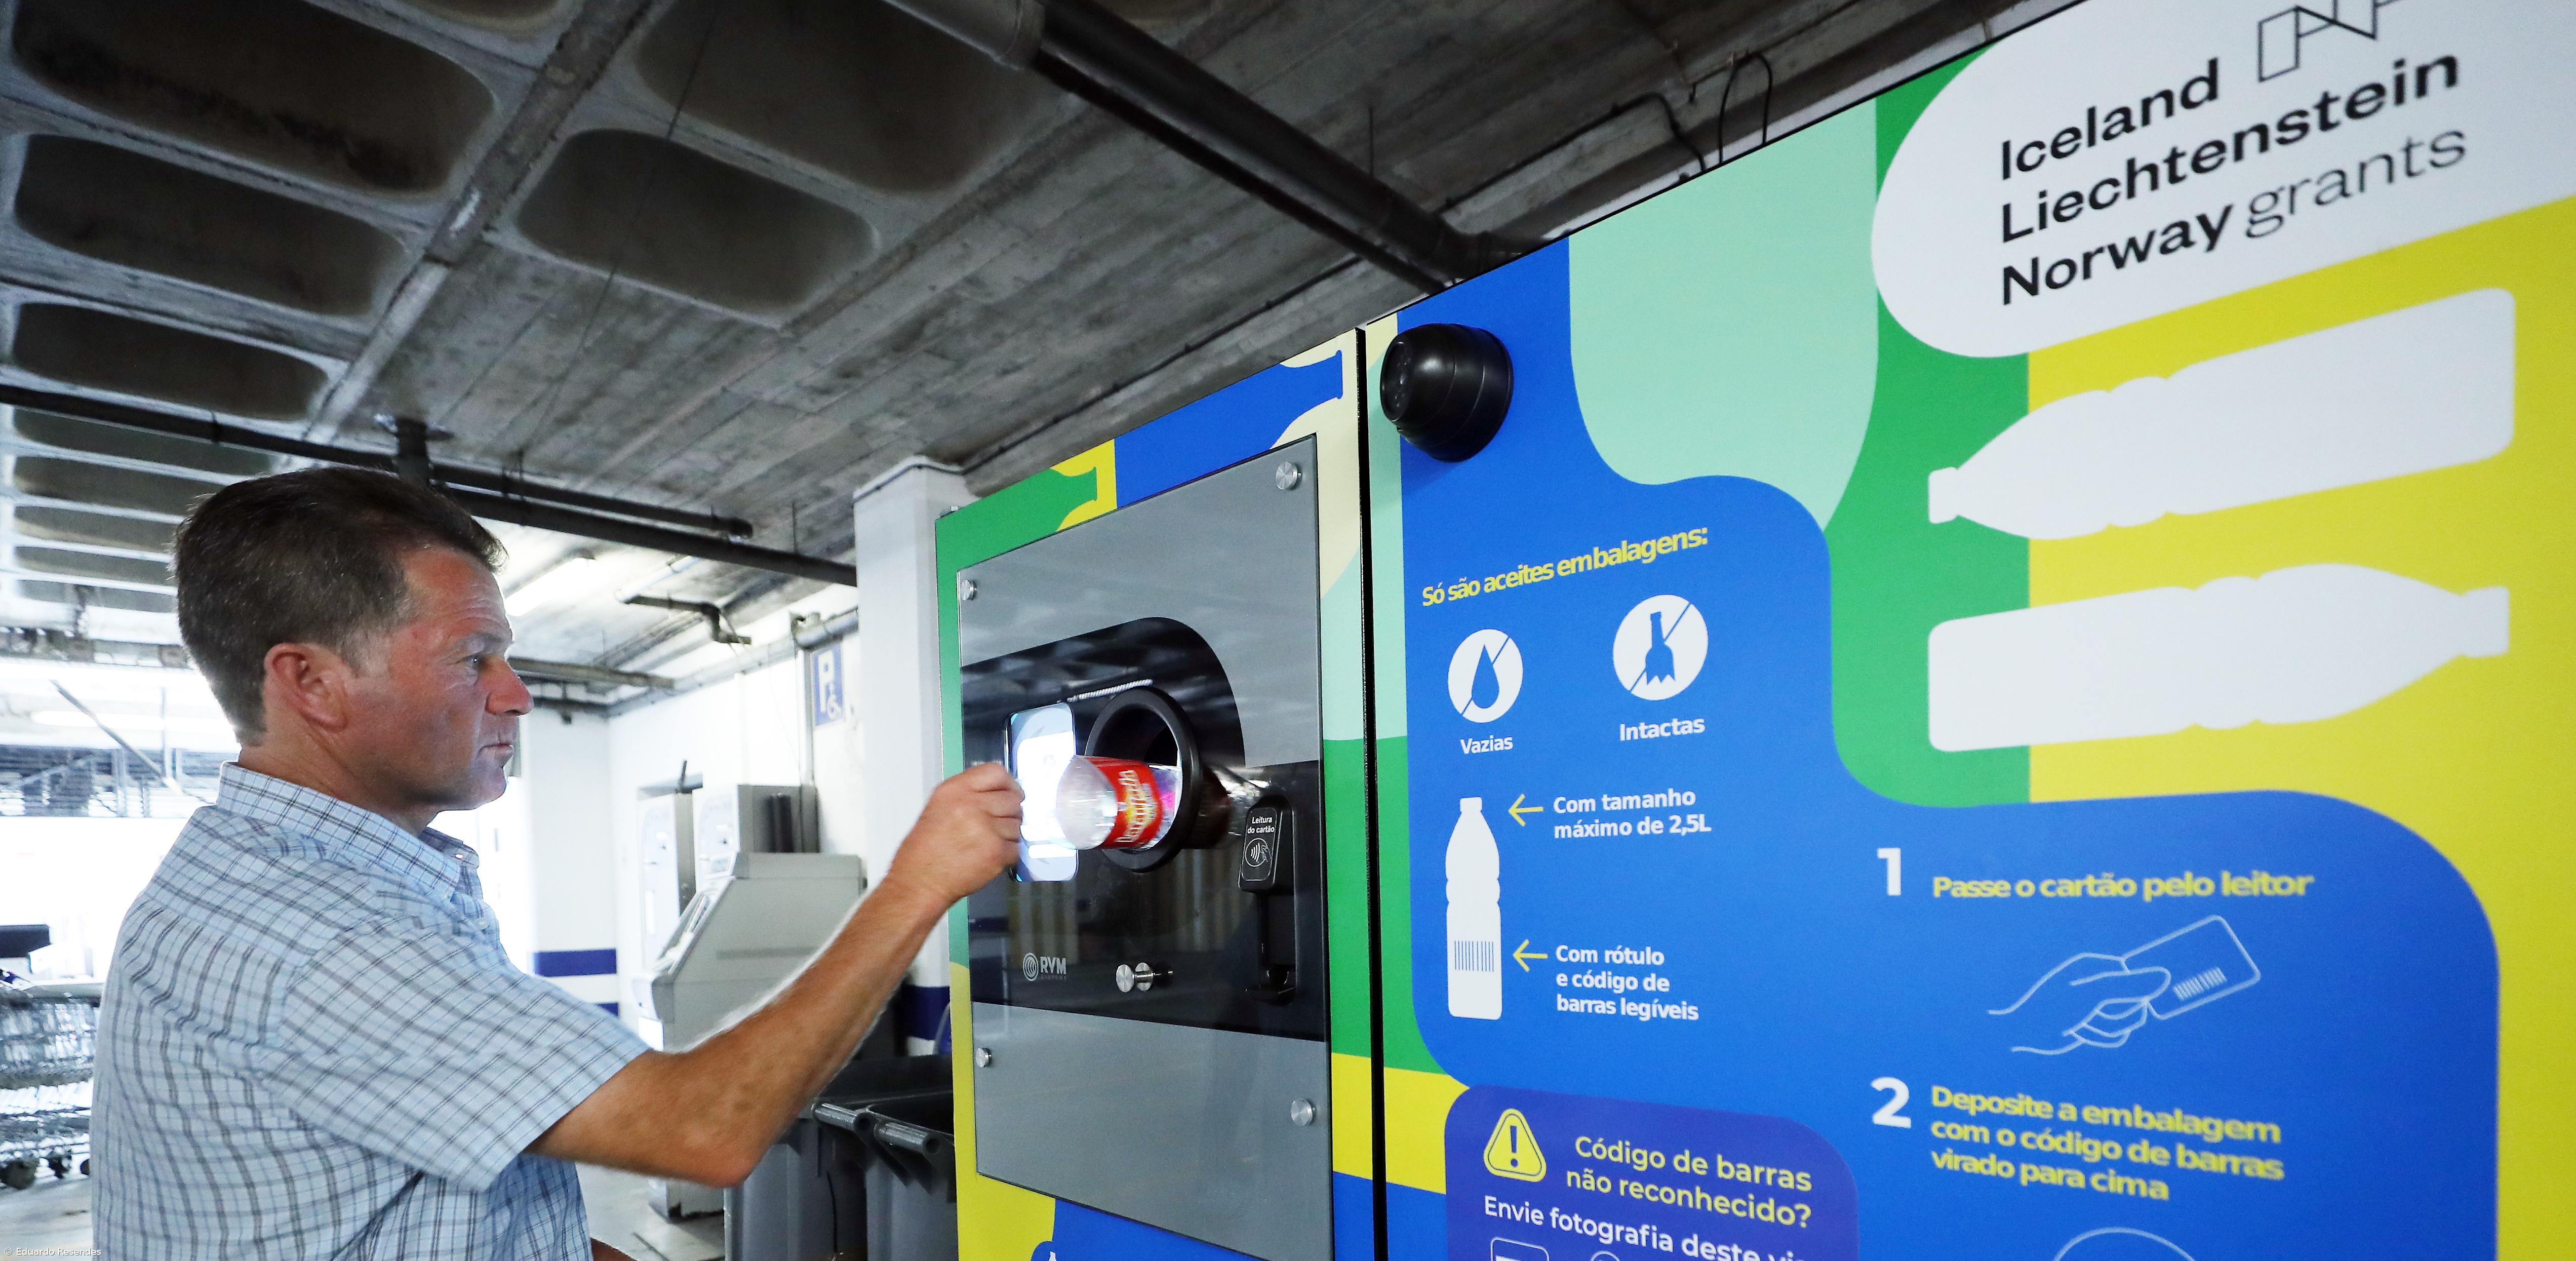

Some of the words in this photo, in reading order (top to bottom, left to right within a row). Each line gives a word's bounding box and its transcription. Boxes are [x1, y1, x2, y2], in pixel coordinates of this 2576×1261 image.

[2001, 57, 2220, 181] Iceland
[2001, 55, 2460, 243] Liechtenstein
[2003, 202, 2233, 305] Norway
[2246, 131, 2465, 238] grants
[1423, 582, 1445, 606] Só
[1448, 577, 1480, 600] são
[1484, 563, 1554, 593] aceites
[1557, 528, 1708, 576] embalagens:
[818, 649, 835, 713] P
[1460, 735, 1513, 754] Vazias
[1620, 719, 1705, 740] Intactas
[1554, 797, 1596, 813] Com
[1602, 789, 1696, 810] tamanho
[1555, 819, 1632, 838] máximo
[1637, 816, 1663, 835] de
[1669, 814, 1712, 835] 2,5L
[1878, 848, 1901, 895] 1
[1933, 877, 2011, 897] Passe
[2015, 880, 2035, 897] o
[2040, 873, 2137, 897] cartão
[2144, 872, 2215, 901] pelo
[2222, 871, 2313, 895] leitor
[1040, 956, 1066, 974] RVM
[1556, 945, 1598, 963] Com
[1605, 945, 1665, 965] rótulo
[1557, 973, 1568, 986] e
[1572, 970, 1638, 994] código
[1643, 973, 1670, 992] de
[1557, 994, 1616, 1014] barras
[1621, 998, 1698, 1021] legíveis
[1872, 1077, 1911, 1128] 2
[1932, 1086, 2053, 1118] Deposite
[2058, 1104, 2077, 1121] a
[2082, 1105, 2280, 1142] embalagem
[1576, 1136, 1665, 1171] Código
[1674, 1150, 1708, 1175] de
[1718, 1155, 1811, 1191] barras
[1931, 1122, 1989, 1143] com
[1997, 1129, 2015, 1146] o
[2020, 1130, 2122, 1162] código
[2128, 1140, 2170, 1165] de
[2177, 1144, 2283, 1179] barras
[1932, 1149, 2015, 1177] virado
[2020, 1164, 2085, 1188] para
[2090, 1169, 2168, 1199] cima
[1567, 1168, 1611, 1193] não
[1620, 1176, 1811, 1228] reconhecido?
[1485, 1196, 1543, 1225] Envie
[1550, 1207, 1673, 1252] fotografia
[1682, 1234, 1760, 1261] deste
